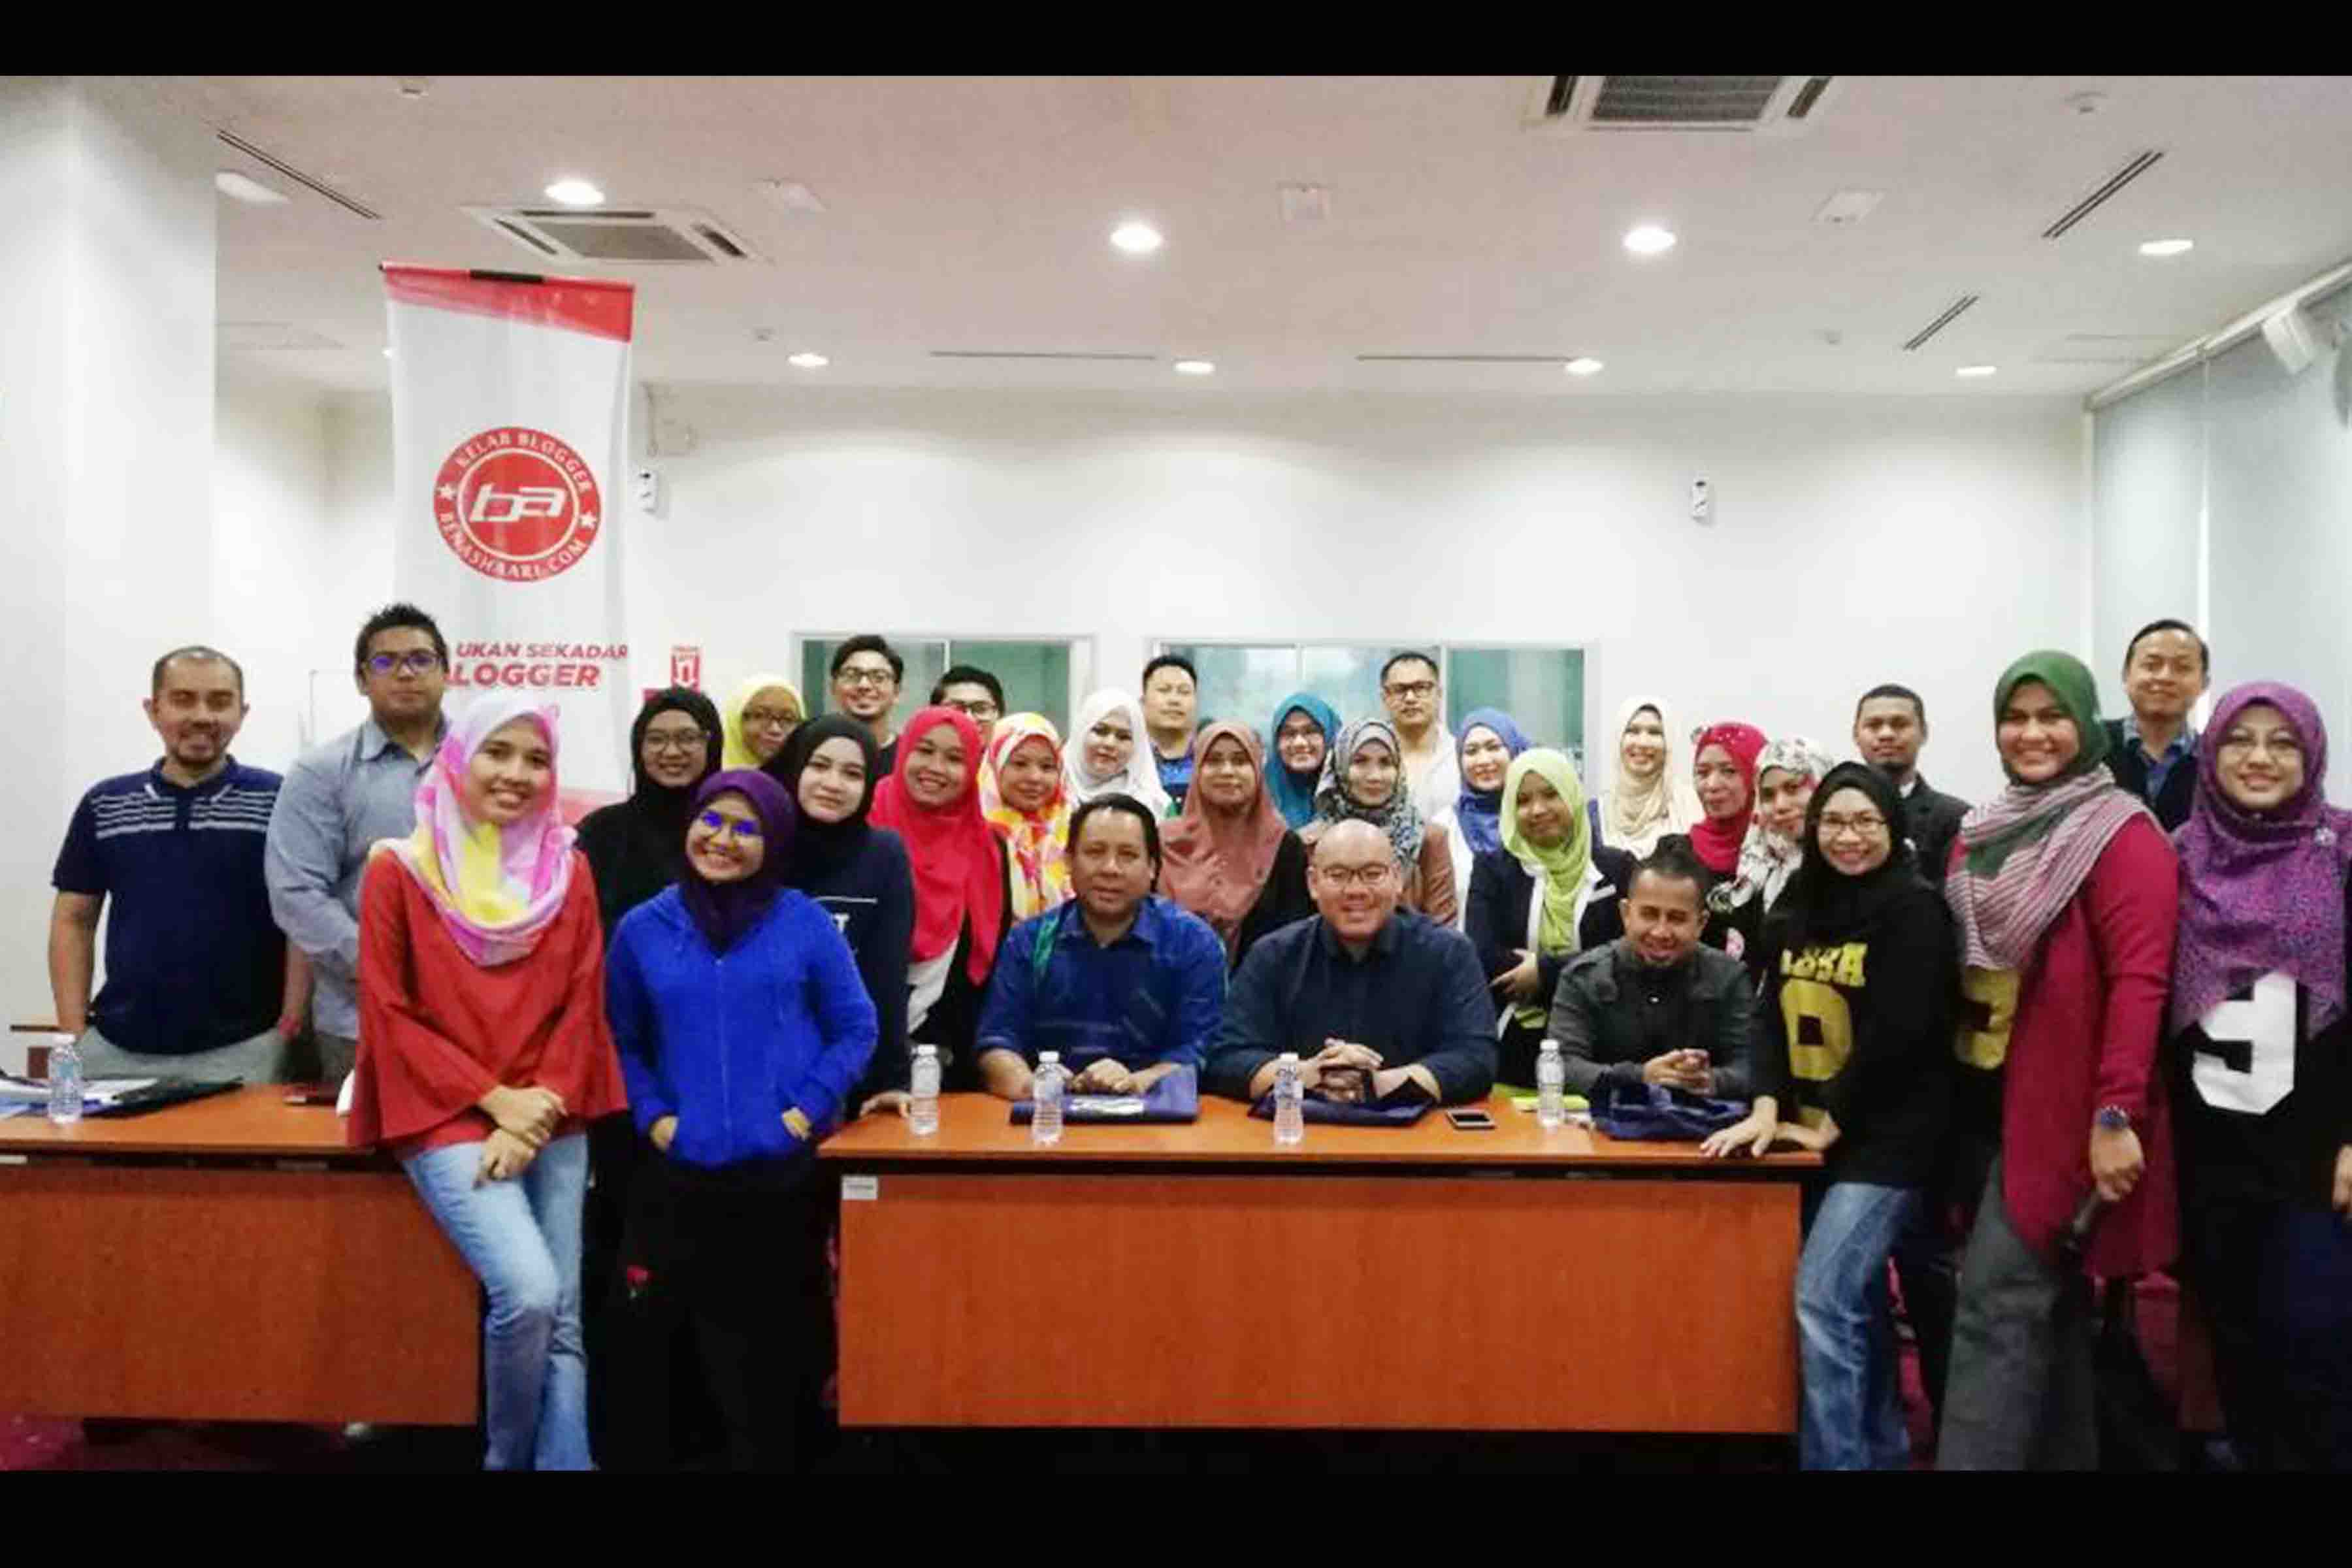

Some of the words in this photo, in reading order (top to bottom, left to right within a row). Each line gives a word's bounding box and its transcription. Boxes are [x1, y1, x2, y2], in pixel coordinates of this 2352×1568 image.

[455, 432, 513, 468] KELAB
[517, 433, 594, 493] BLOGGER
[456, 642, 521, 659] UKAN
[525, 643, 628, 660] SEKADAR
